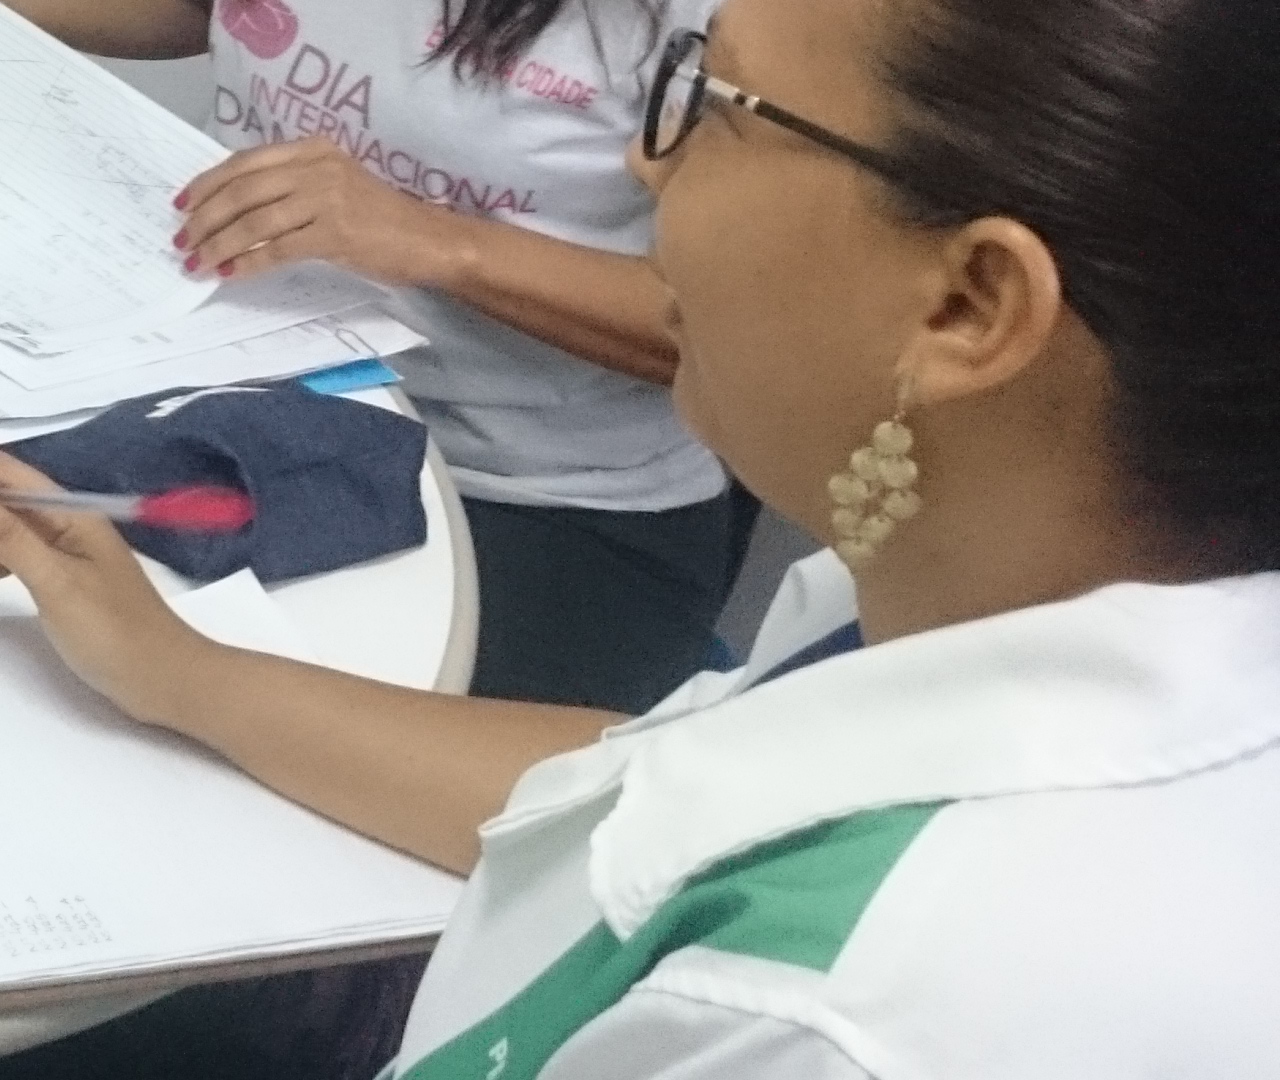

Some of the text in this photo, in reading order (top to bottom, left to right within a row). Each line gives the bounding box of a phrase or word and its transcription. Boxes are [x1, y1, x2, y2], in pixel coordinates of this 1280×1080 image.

[286, 42, 372, 129] DIA
[516, 59, 598, 110] CIDADE
[249, 73, 538, 214] INTERNACIONAL
